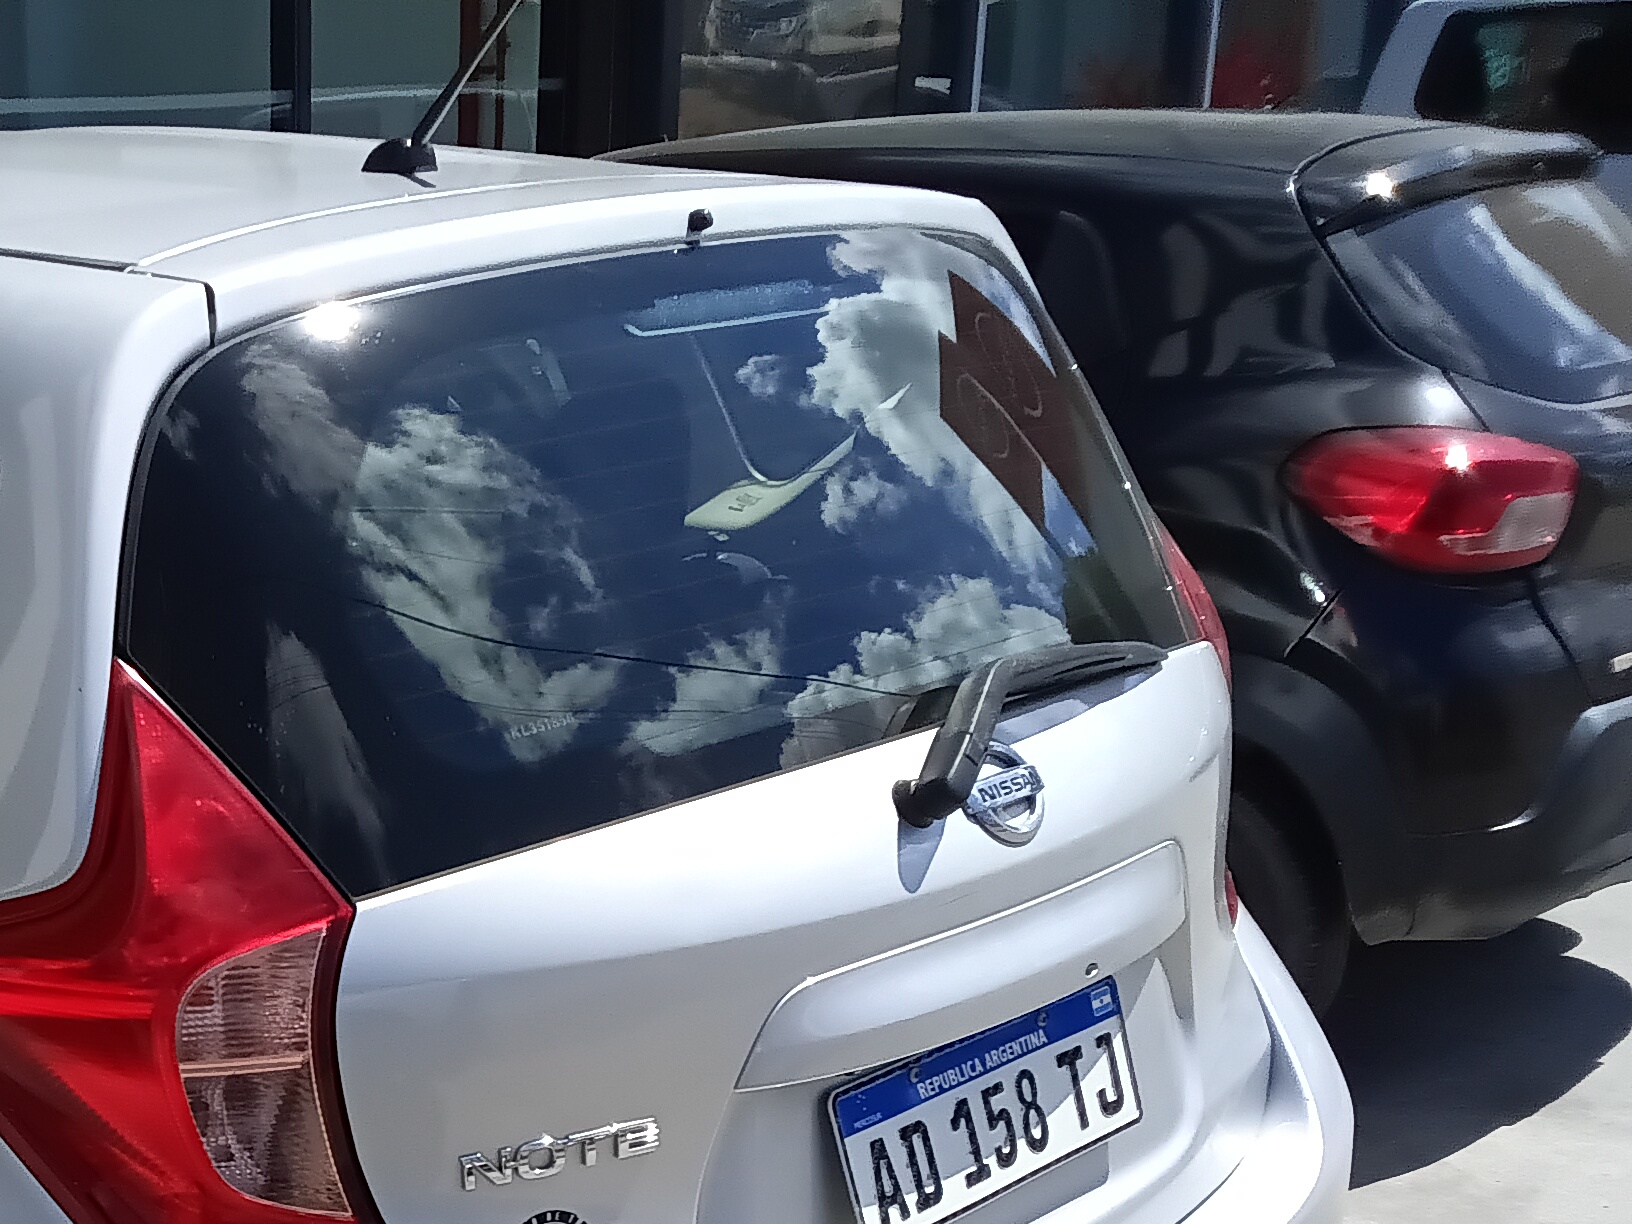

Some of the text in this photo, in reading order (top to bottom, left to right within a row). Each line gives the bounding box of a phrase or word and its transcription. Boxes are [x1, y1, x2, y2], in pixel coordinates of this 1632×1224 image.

[977, 769, 1039, 802] NISSAN
[916, 1029, 1048, 1101] REPUBLICA ARGENTINA
[950, 1068, 1050, 1189] 158
[1056, 1031, 1125, 1132] TJ
[458, 1115, 661, 1191] NOTE
